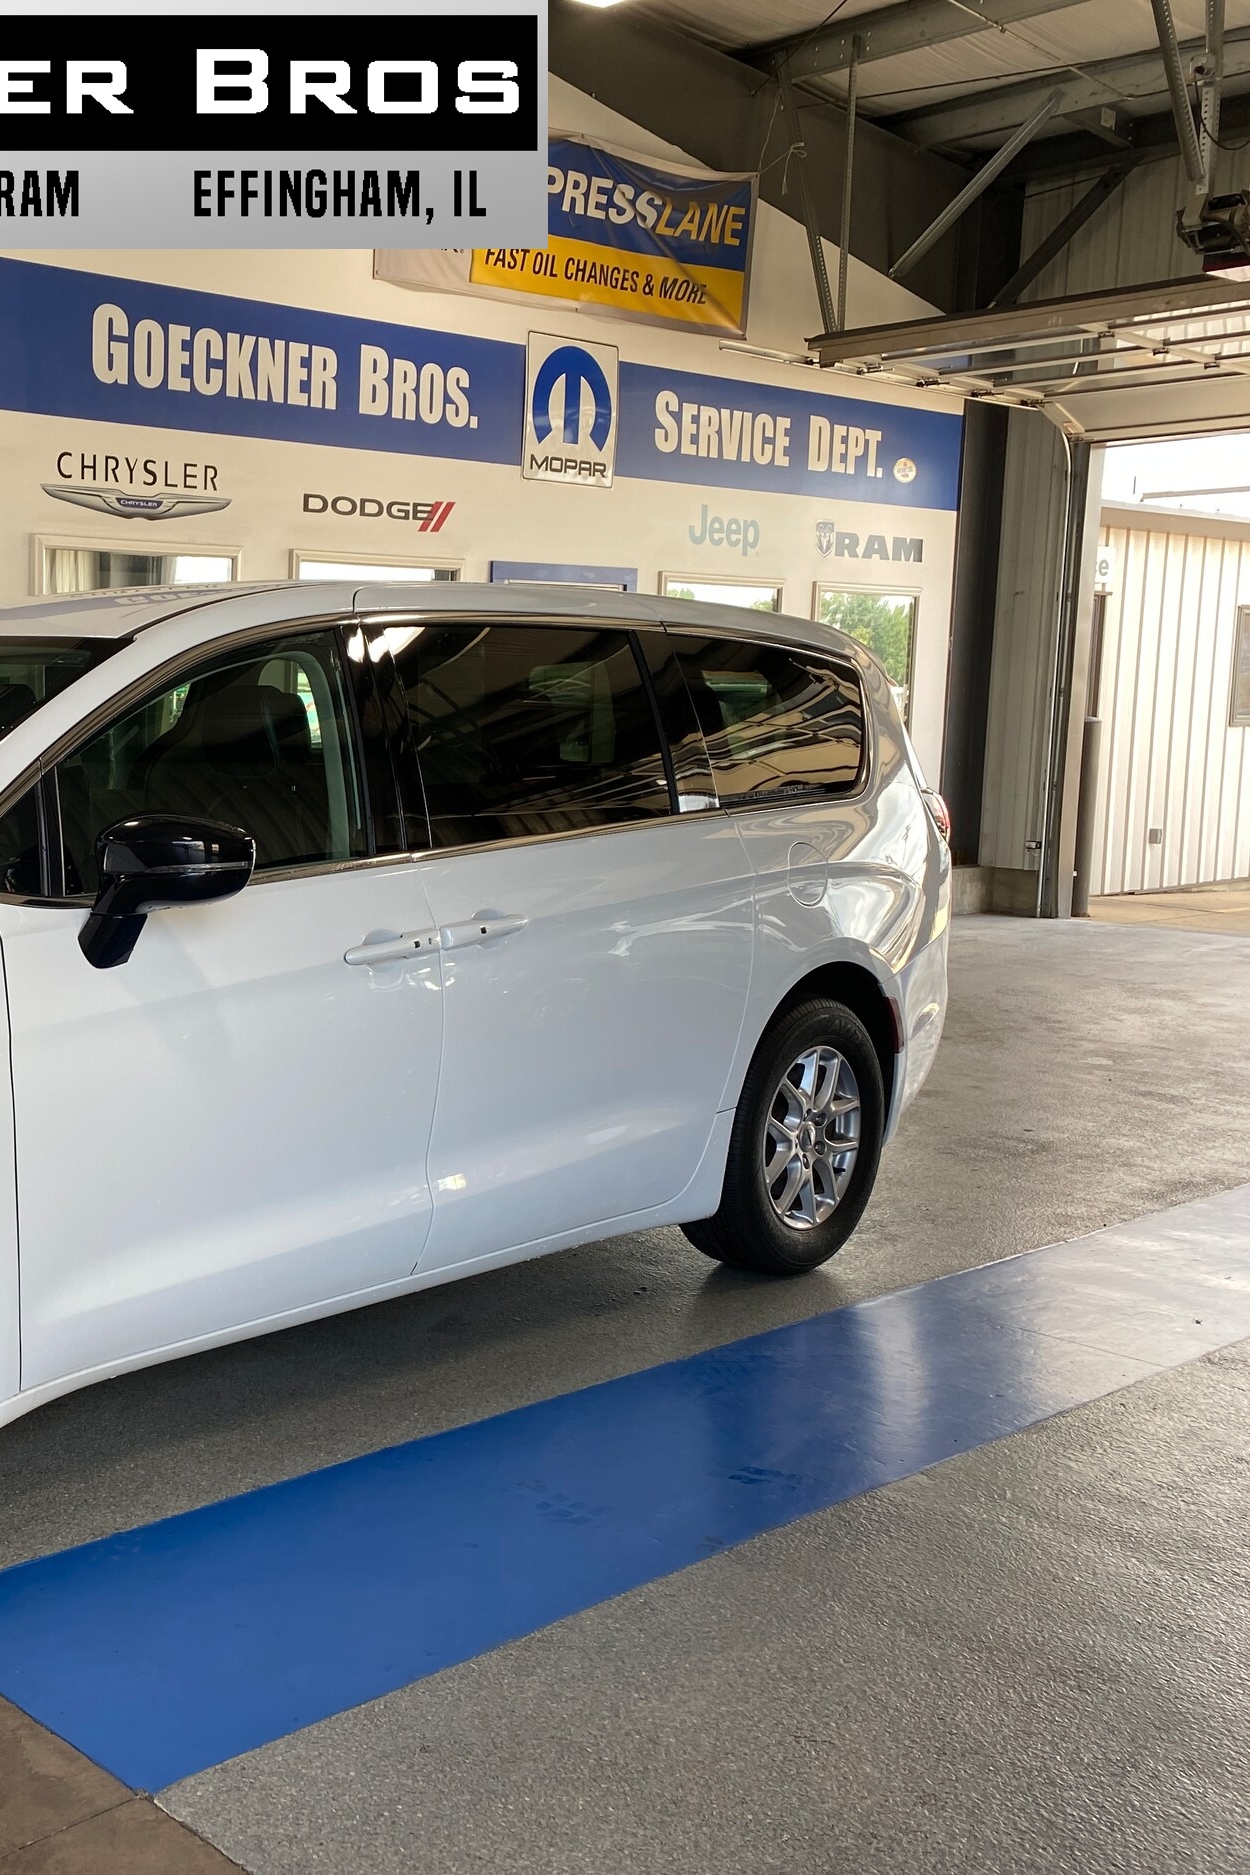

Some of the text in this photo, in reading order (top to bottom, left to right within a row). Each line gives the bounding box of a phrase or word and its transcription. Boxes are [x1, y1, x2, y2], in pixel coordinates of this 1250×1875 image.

[485, 249, 708, 305] FAST OIL CHANGES & MORE
[91, 303, 479, 430] GOECKNER BROS.
[654, 390, 884, 479] SERVICE DEPT.
[56, 451, 218, 492] CHRYSLER
[529, 453, 608, 479] MOPAR
[120, 499, 159, 508] CHRYSLER
[303, 493, 435, 522] DODGE
[688, 504, 760, 557] Jeep
[834, 531, 924, 563] RAM
